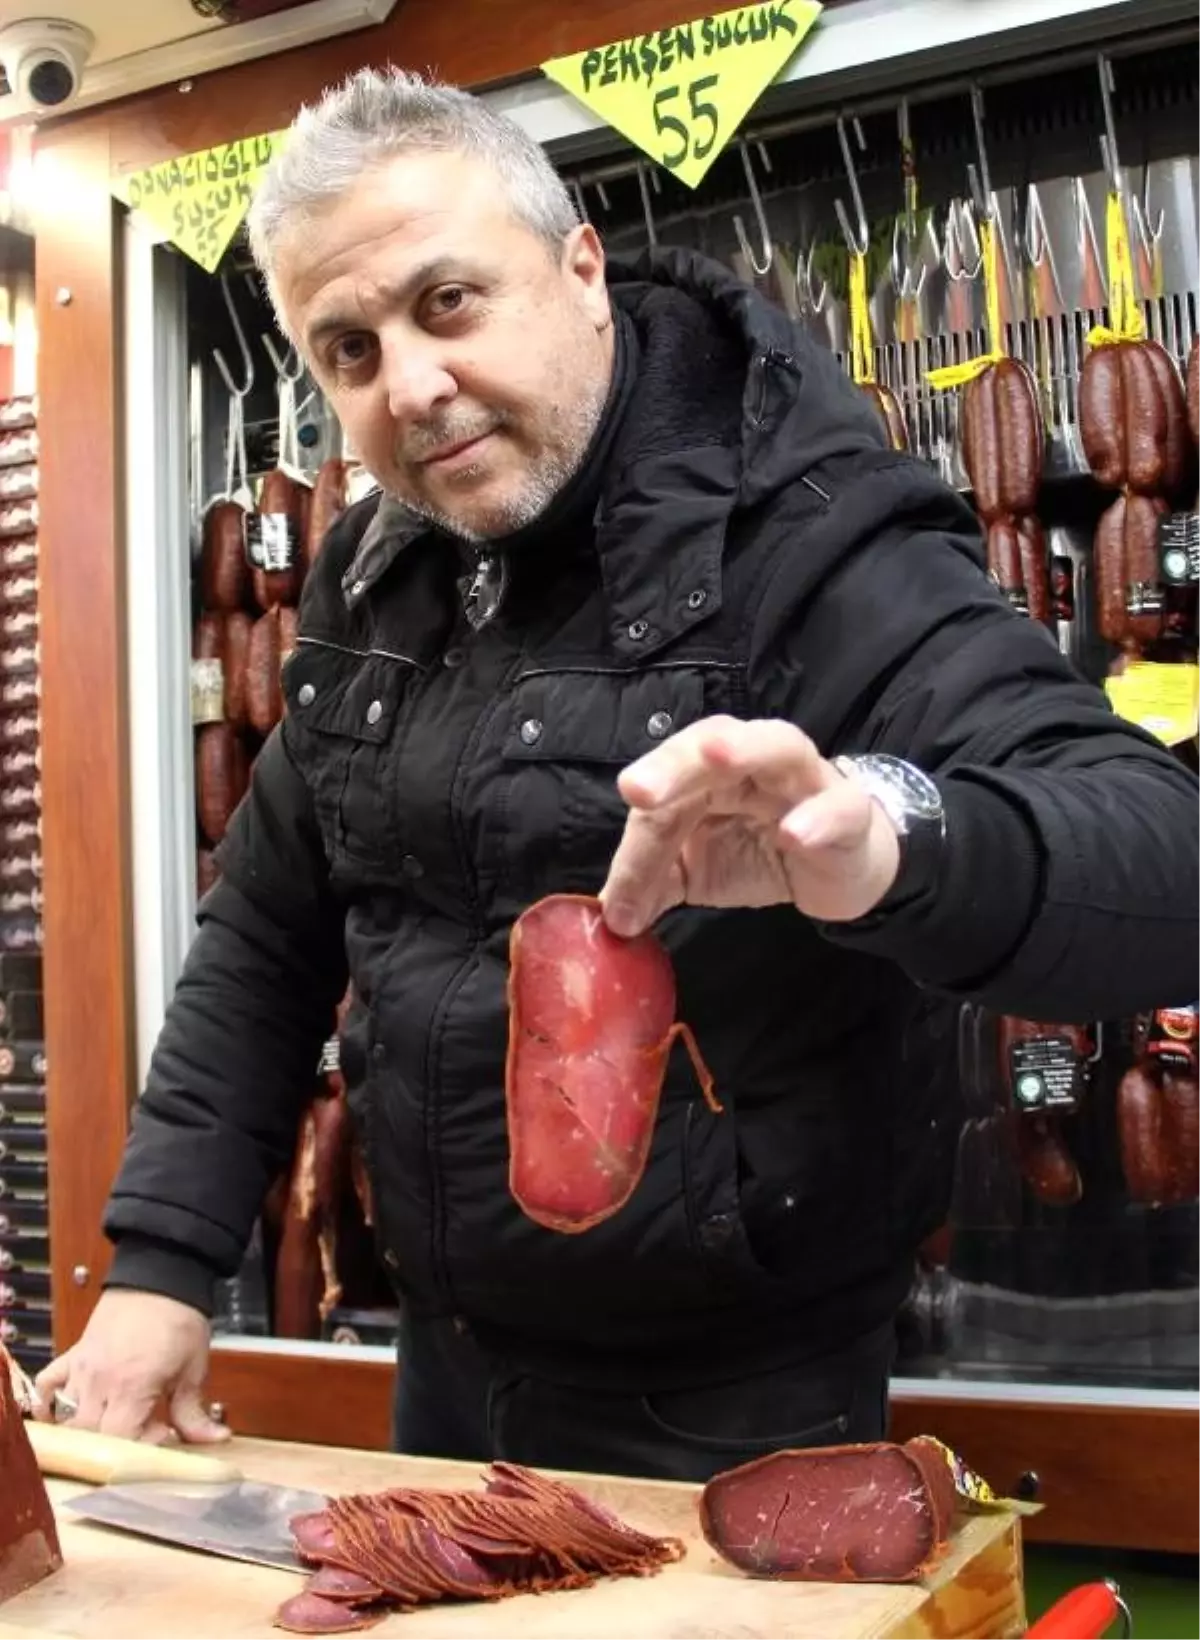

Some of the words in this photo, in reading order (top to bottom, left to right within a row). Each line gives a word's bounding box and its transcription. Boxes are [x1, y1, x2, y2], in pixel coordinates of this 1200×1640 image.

[701, 0, 798, 57] SUCUK
[653, 73, 720, 169] 55
[172, 175, 253, 237] SUCUK
